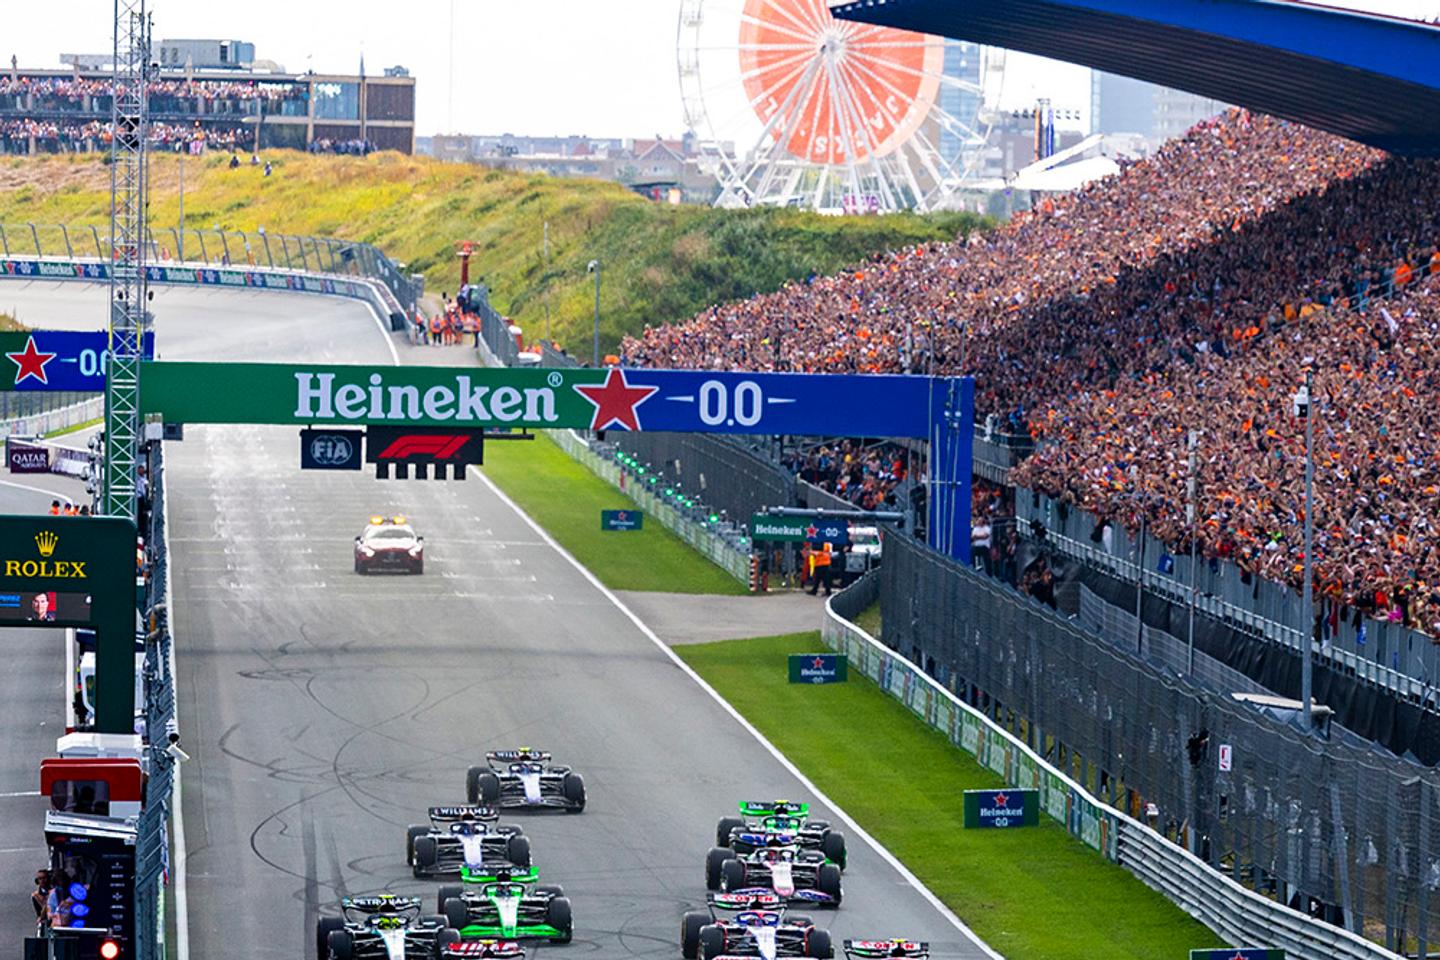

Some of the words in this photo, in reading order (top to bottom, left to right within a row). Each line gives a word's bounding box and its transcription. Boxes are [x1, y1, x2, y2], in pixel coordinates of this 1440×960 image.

[293, 372, 559, 422] Heineken
[699, 380, 763, 426] 0.0
[12, 453, 47, 464] QATAR
[755, 524, 803, 536] Heineken
[5, 560, 87, 578] ROLEX
[980, 807, 1024, 817] Heineken
